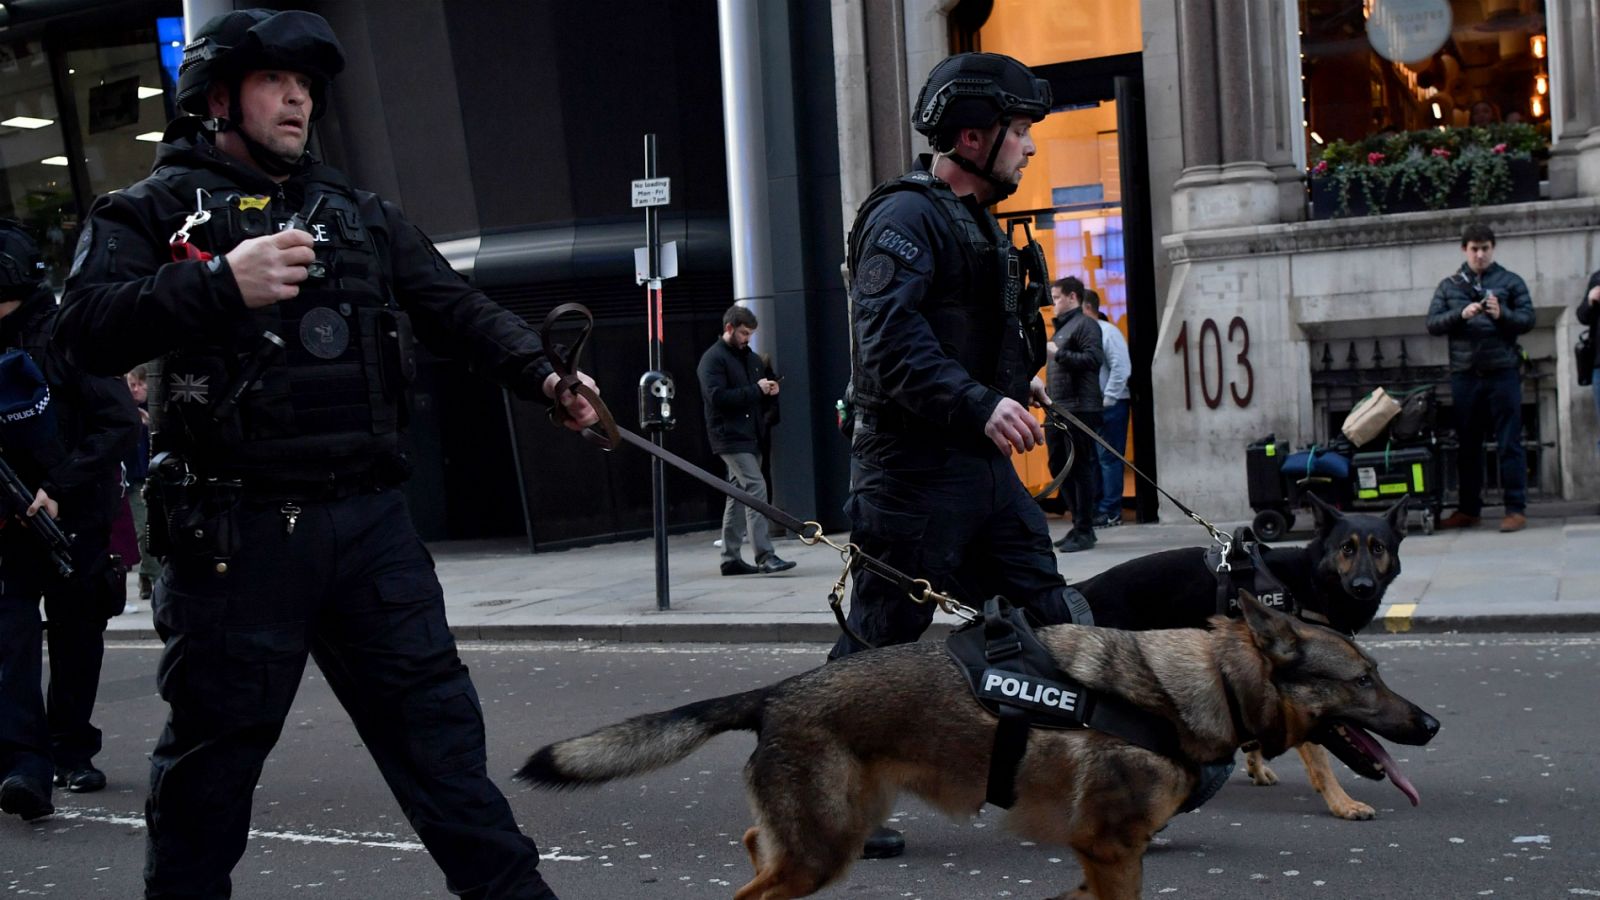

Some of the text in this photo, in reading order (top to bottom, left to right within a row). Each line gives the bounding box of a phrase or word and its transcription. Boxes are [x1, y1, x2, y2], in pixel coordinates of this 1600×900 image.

[1174, 316, 1254, 411] 103
[6, 407, 36, 421] POLICE
[1229, 593, 1284, 610] PICE
[984, 674, 1078, 711] POLICE
